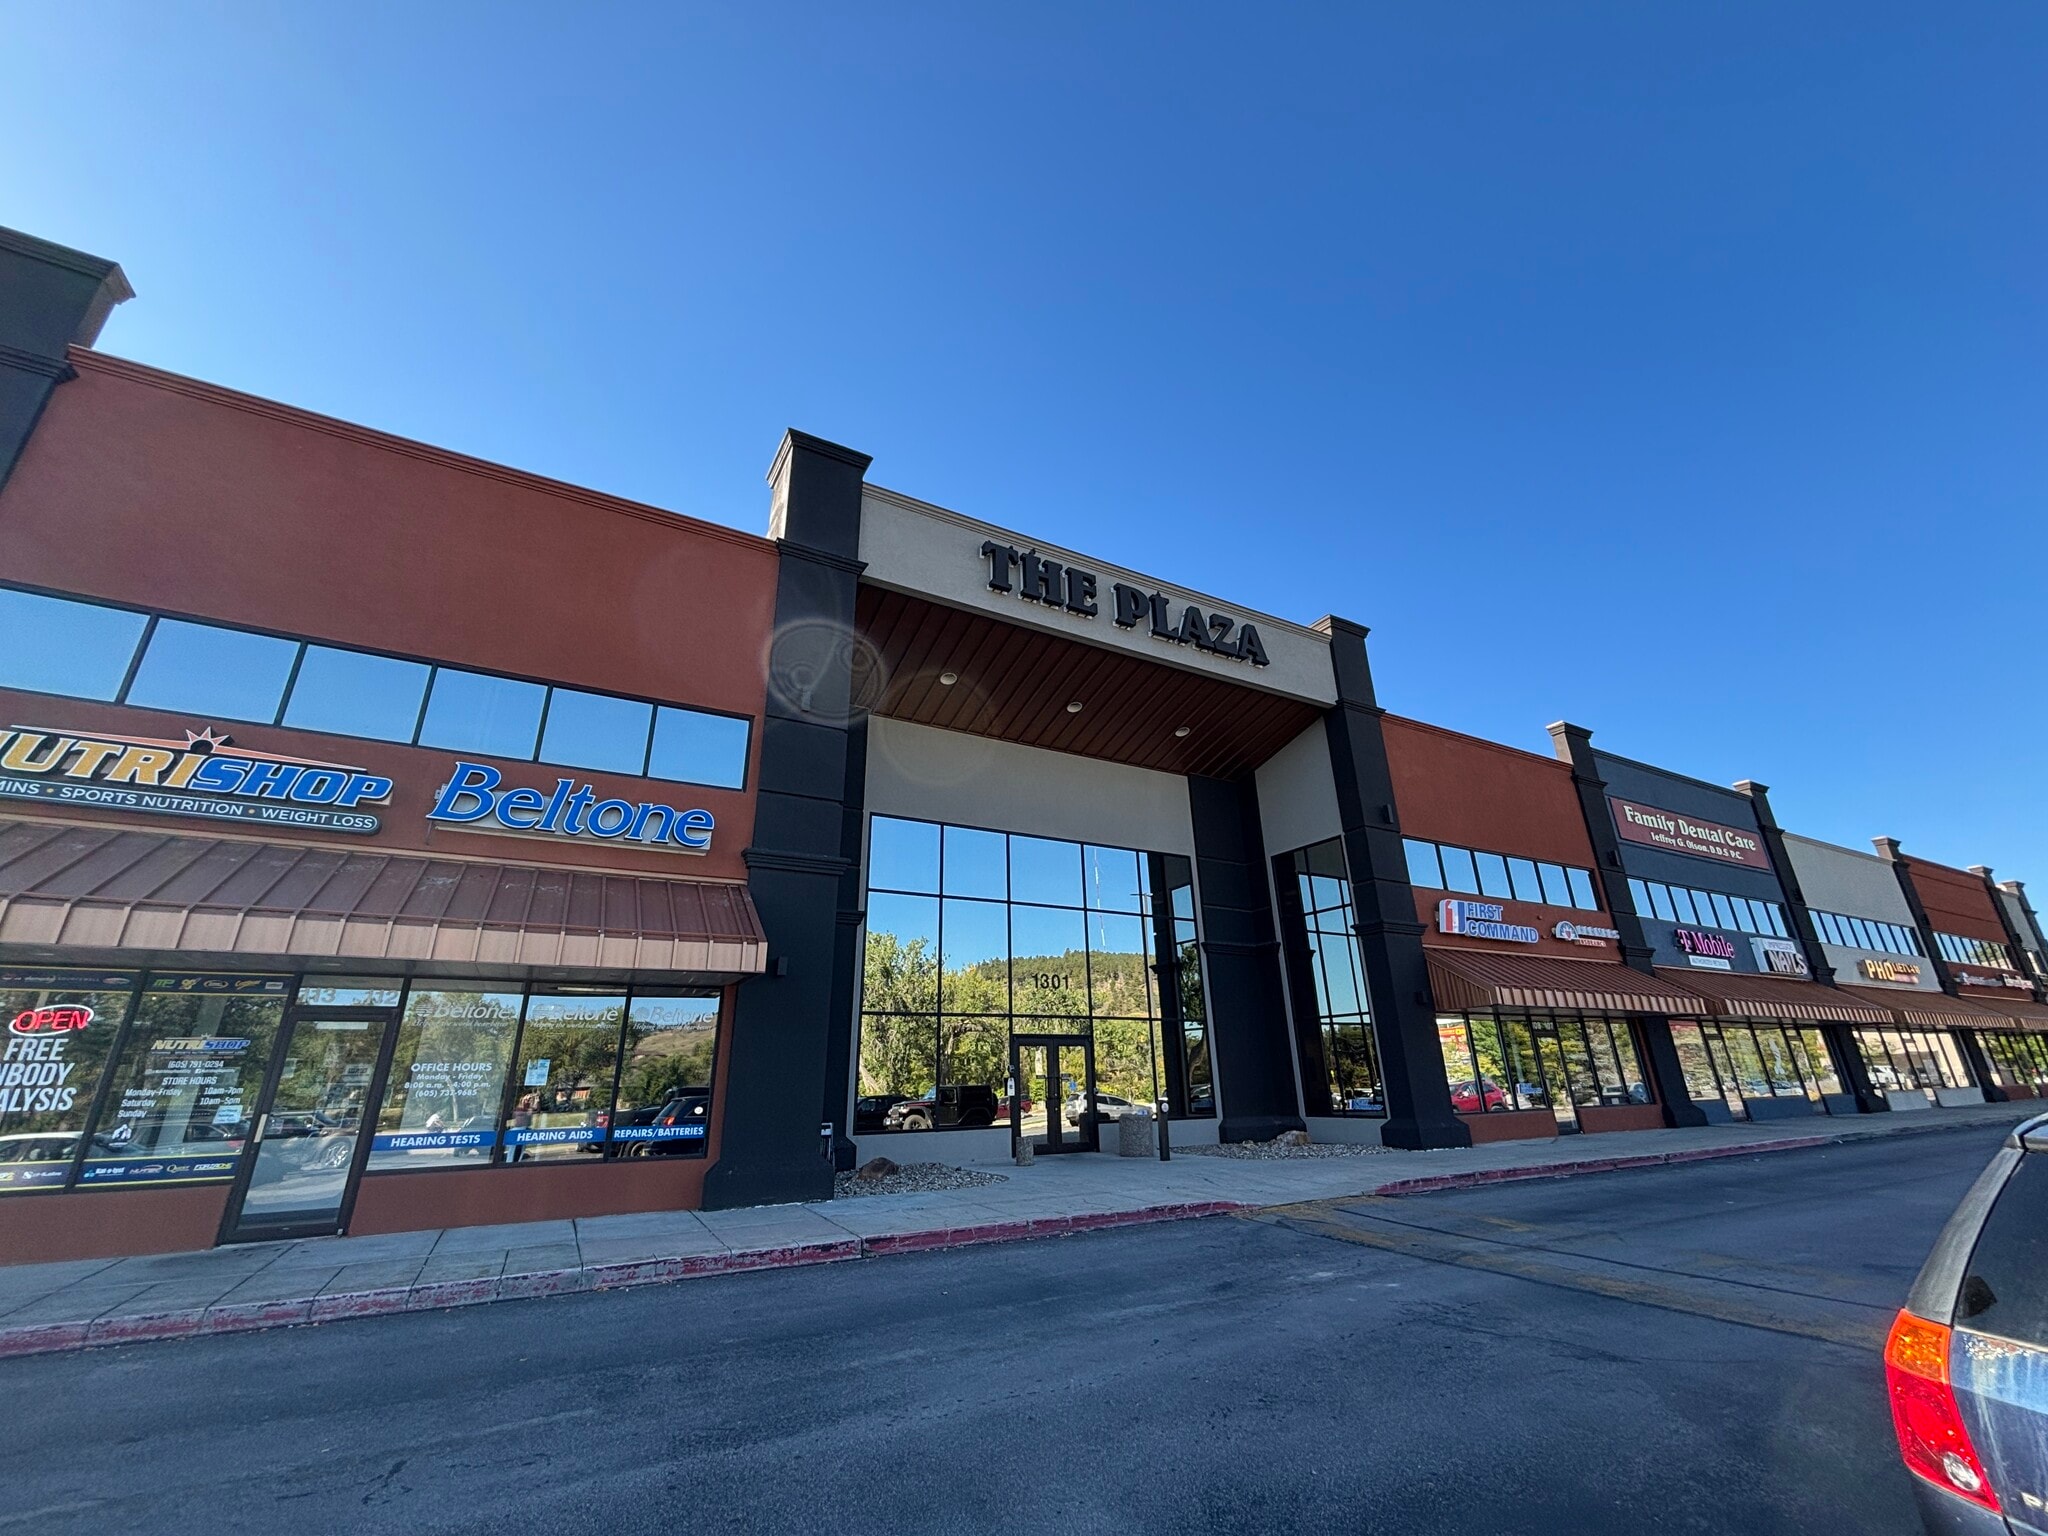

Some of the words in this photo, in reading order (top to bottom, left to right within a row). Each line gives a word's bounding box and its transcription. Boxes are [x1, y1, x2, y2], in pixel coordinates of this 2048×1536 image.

[980, 540, 1098, 619] THE
[1111, 582, 1270, 668] PLAZA
[59, 787, 138, 805] SPORTS
[142, 795, 243, 816] NUTRITION
[262, 808, 331, 826] WEIGHT
[333, 814, 374, 830] LOSS
[426, 761, 715, 847] Beltone
[1623, 805, 1676, 836] Family
[1677, 819, 1725, 844] Dental
[1724, 831, 1757, 851] Care
[1467, 902, 1503, 920] FIRST
[1468, 920, 1538, 942] COMMAND
[1767, 950, 1808, 974] NAILS
[1032, 973, 1069, 990] 1301
[433, 1000, 509, 1019] Beltone
[551, 1003, 618, 1021] Beltone
[651, 1006, 713, 1023] Beltone
[15, 1010, 90, 1031] OPEN
[3, 1038, 70, 1061] FREE
[151, 1039, 251, 1050] NUTRISHOP
[411, 1063, 450, 1072] OFFICE
[452, 1062, 493, 1072] HOURS
[161, 1077, 189, 1085] STORE
[189, 1076, 218, 1085] HOURS
[416, 1073, 451, 1082] Monday
[458, 1073, 484, 1081] Friday
[415, 1089, 438, 1098] (605)
[121, 1098, 156, 1107] Saturday
[117, 1109, 147, 1119] Sunday
[391, 1136, 446, 1147] HEARING
[449, 1134, 481, 1145] TESTS
[516, 1131, 566, 1142] HEARING
[568, 1130, 593, 1140] AIDS
[613, 1126, 704, 1138] REPAIRS/BATTERIES
